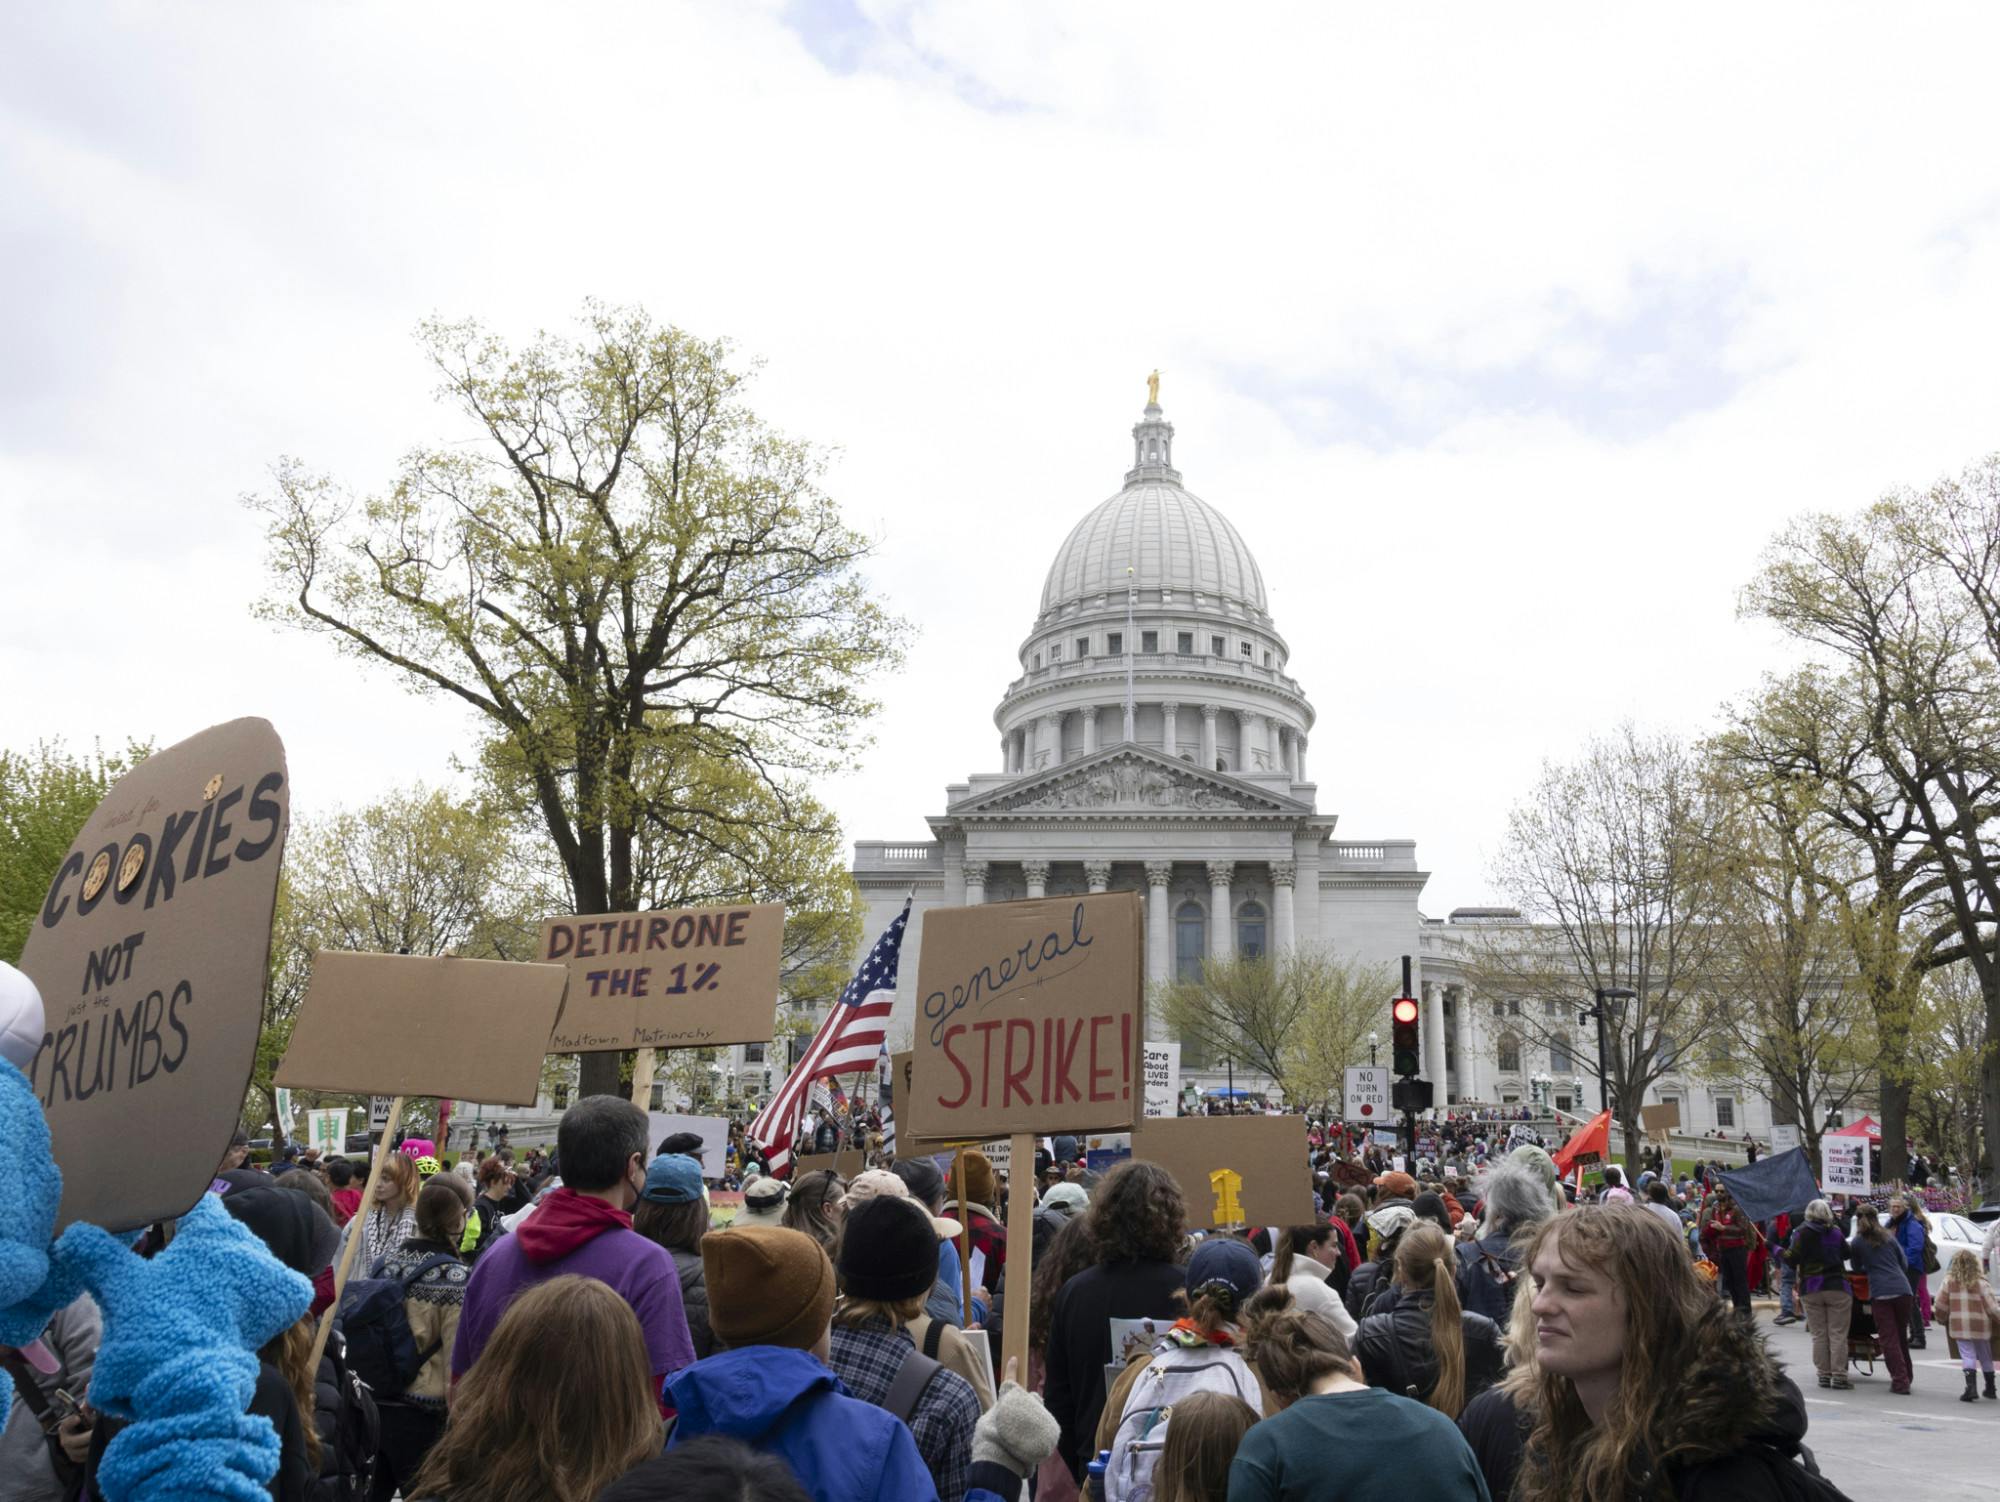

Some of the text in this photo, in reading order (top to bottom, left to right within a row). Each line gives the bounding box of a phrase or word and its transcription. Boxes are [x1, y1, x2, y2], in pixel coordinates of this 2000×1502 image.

[43, 772, 284, 928] COOKIES
[547, 911, 750, 960] DETHRONE
[82, 931, 145, 996] NOT
[586, 962, 721, 997] THE 1%
[924, 902, 1093, 1047] general
[93, 996, 110, 1008] the
[553, 1027, 715, 1048] Madtown Matriarchy
[937, 1013, 1131, 1109] STRIKE!
[1147, 1071, 1169, 1079] LIVES
[1359, 1071, 1373, 1082] NO
[1356, 1084, 1377, 1092] TURN
[376, 1095, 395, 1103] ON
[1350, 1094, 1383, 1103] ON RED
[374, 1104, 393, 1114] WA
